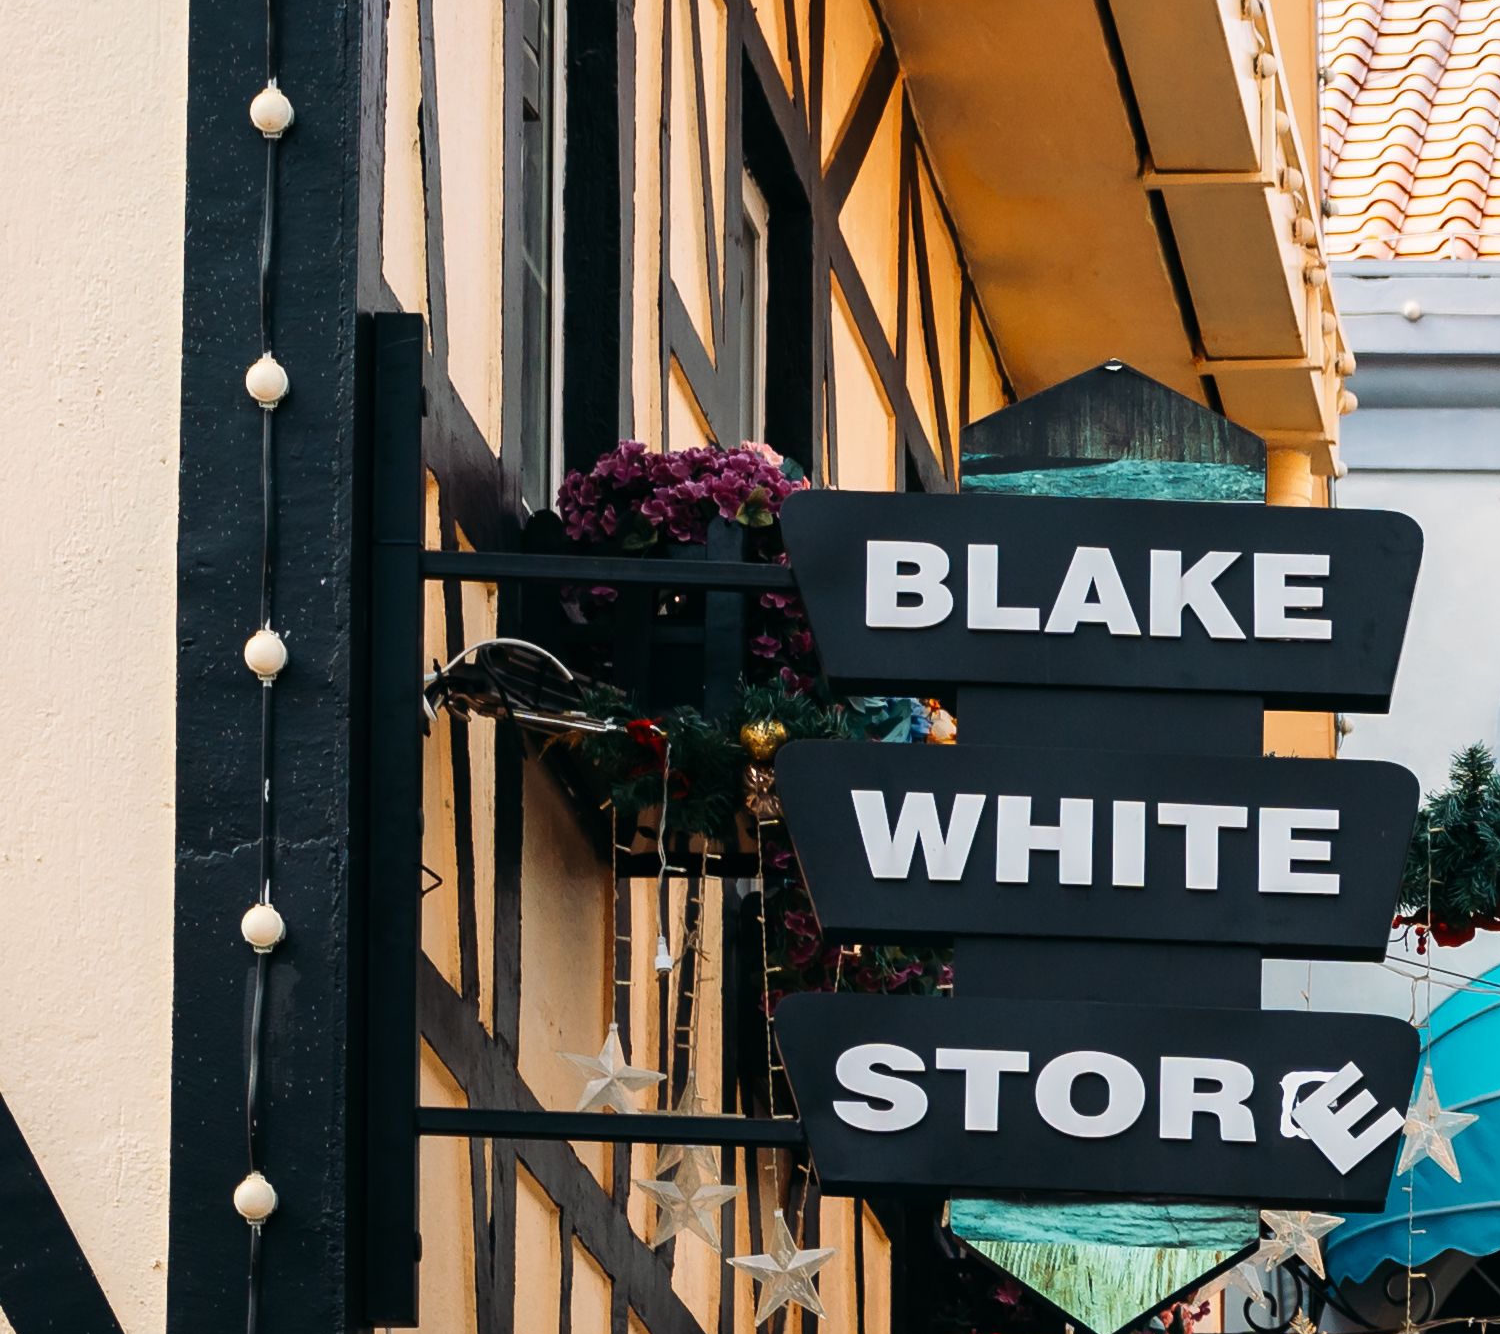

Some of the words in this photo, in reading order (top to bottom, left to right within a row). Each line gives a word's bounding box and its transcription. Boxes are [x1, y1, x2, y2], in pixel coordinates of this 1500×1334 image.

[865, 540, 1332, 641] BLAKE
[850, 789, 1340, 894] WHITE
[832, 1042, 1404, 1175] STORE
